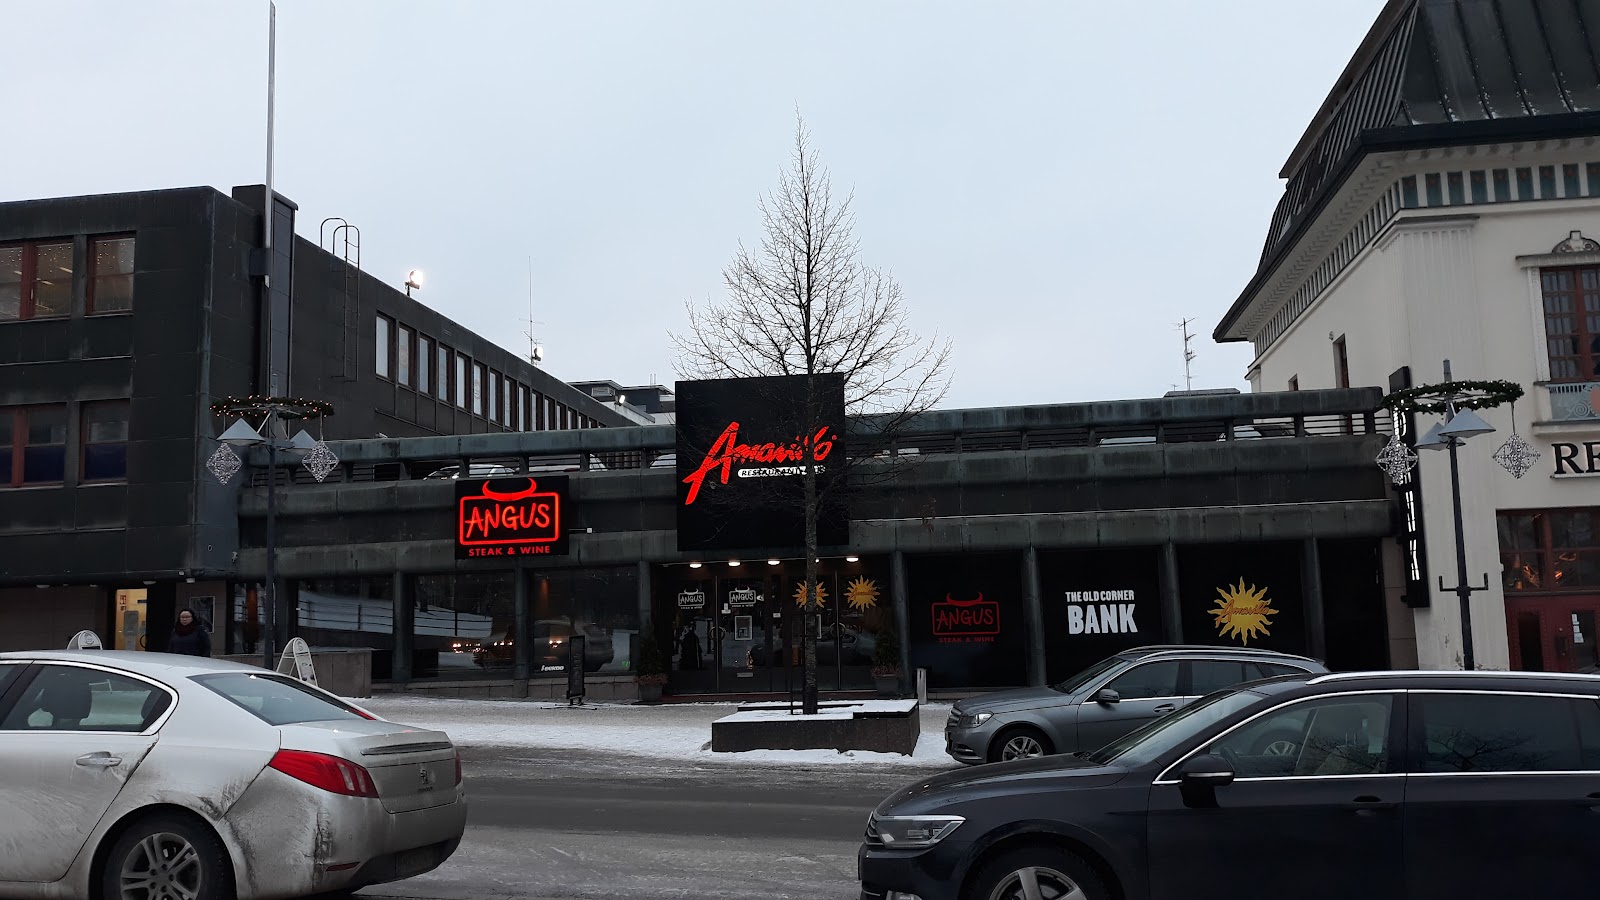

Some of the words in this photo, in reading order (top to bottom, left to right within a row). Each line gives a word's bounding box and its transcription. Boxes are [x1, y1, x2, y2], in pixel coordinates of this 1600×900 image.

[682, 421, 834, 505] Amarilo
[465, 502, 550, 539] ANGUS
[468, 547, 503, 557] STEAK
[507, 547, 516, 555] &
[519, 545, 550, 554] WINE
[680, 595, 703, 605] ANGUS
[731, 593, 754, 603] ANGUS
[1065, 591, 1083, 602] THE
[1083, 590, 1100, 602] OLD
[1100, 589, 1135, 601] CORNER
[935, 607, 994, 631] ANGUS
[1067, 603, 1138, 635] BANK
